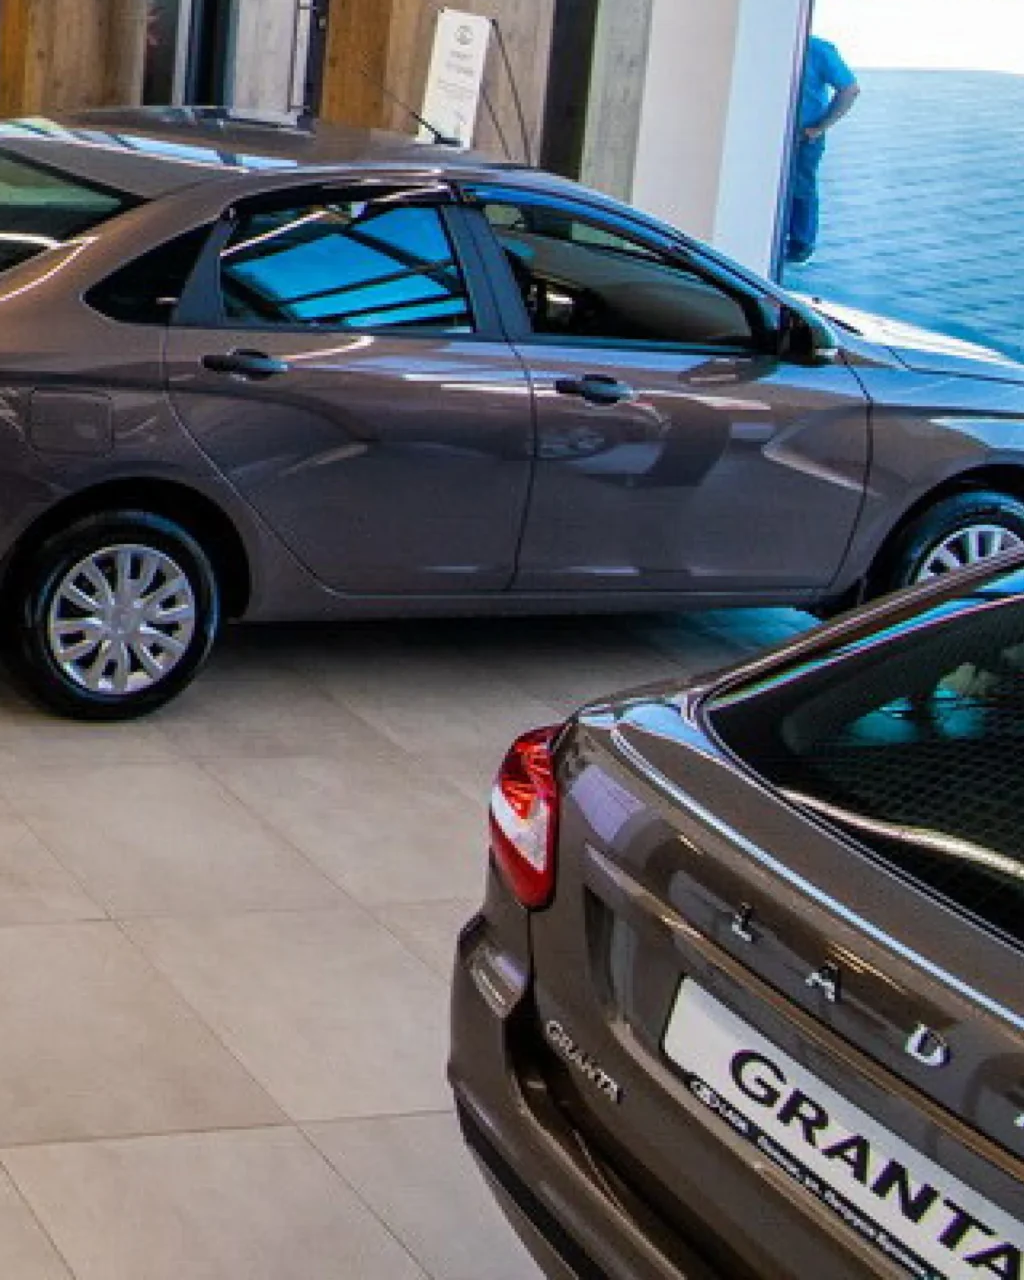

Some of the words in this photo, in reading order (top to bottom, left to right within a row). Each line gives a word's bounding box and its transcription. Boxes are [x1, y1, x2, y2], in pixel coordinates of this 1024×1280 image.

[545, 1019, 619, 1103] GRANTA
[731, 901, 1024, 1128] LAD
[729, 1049, 1024, 1280] GRANTA
